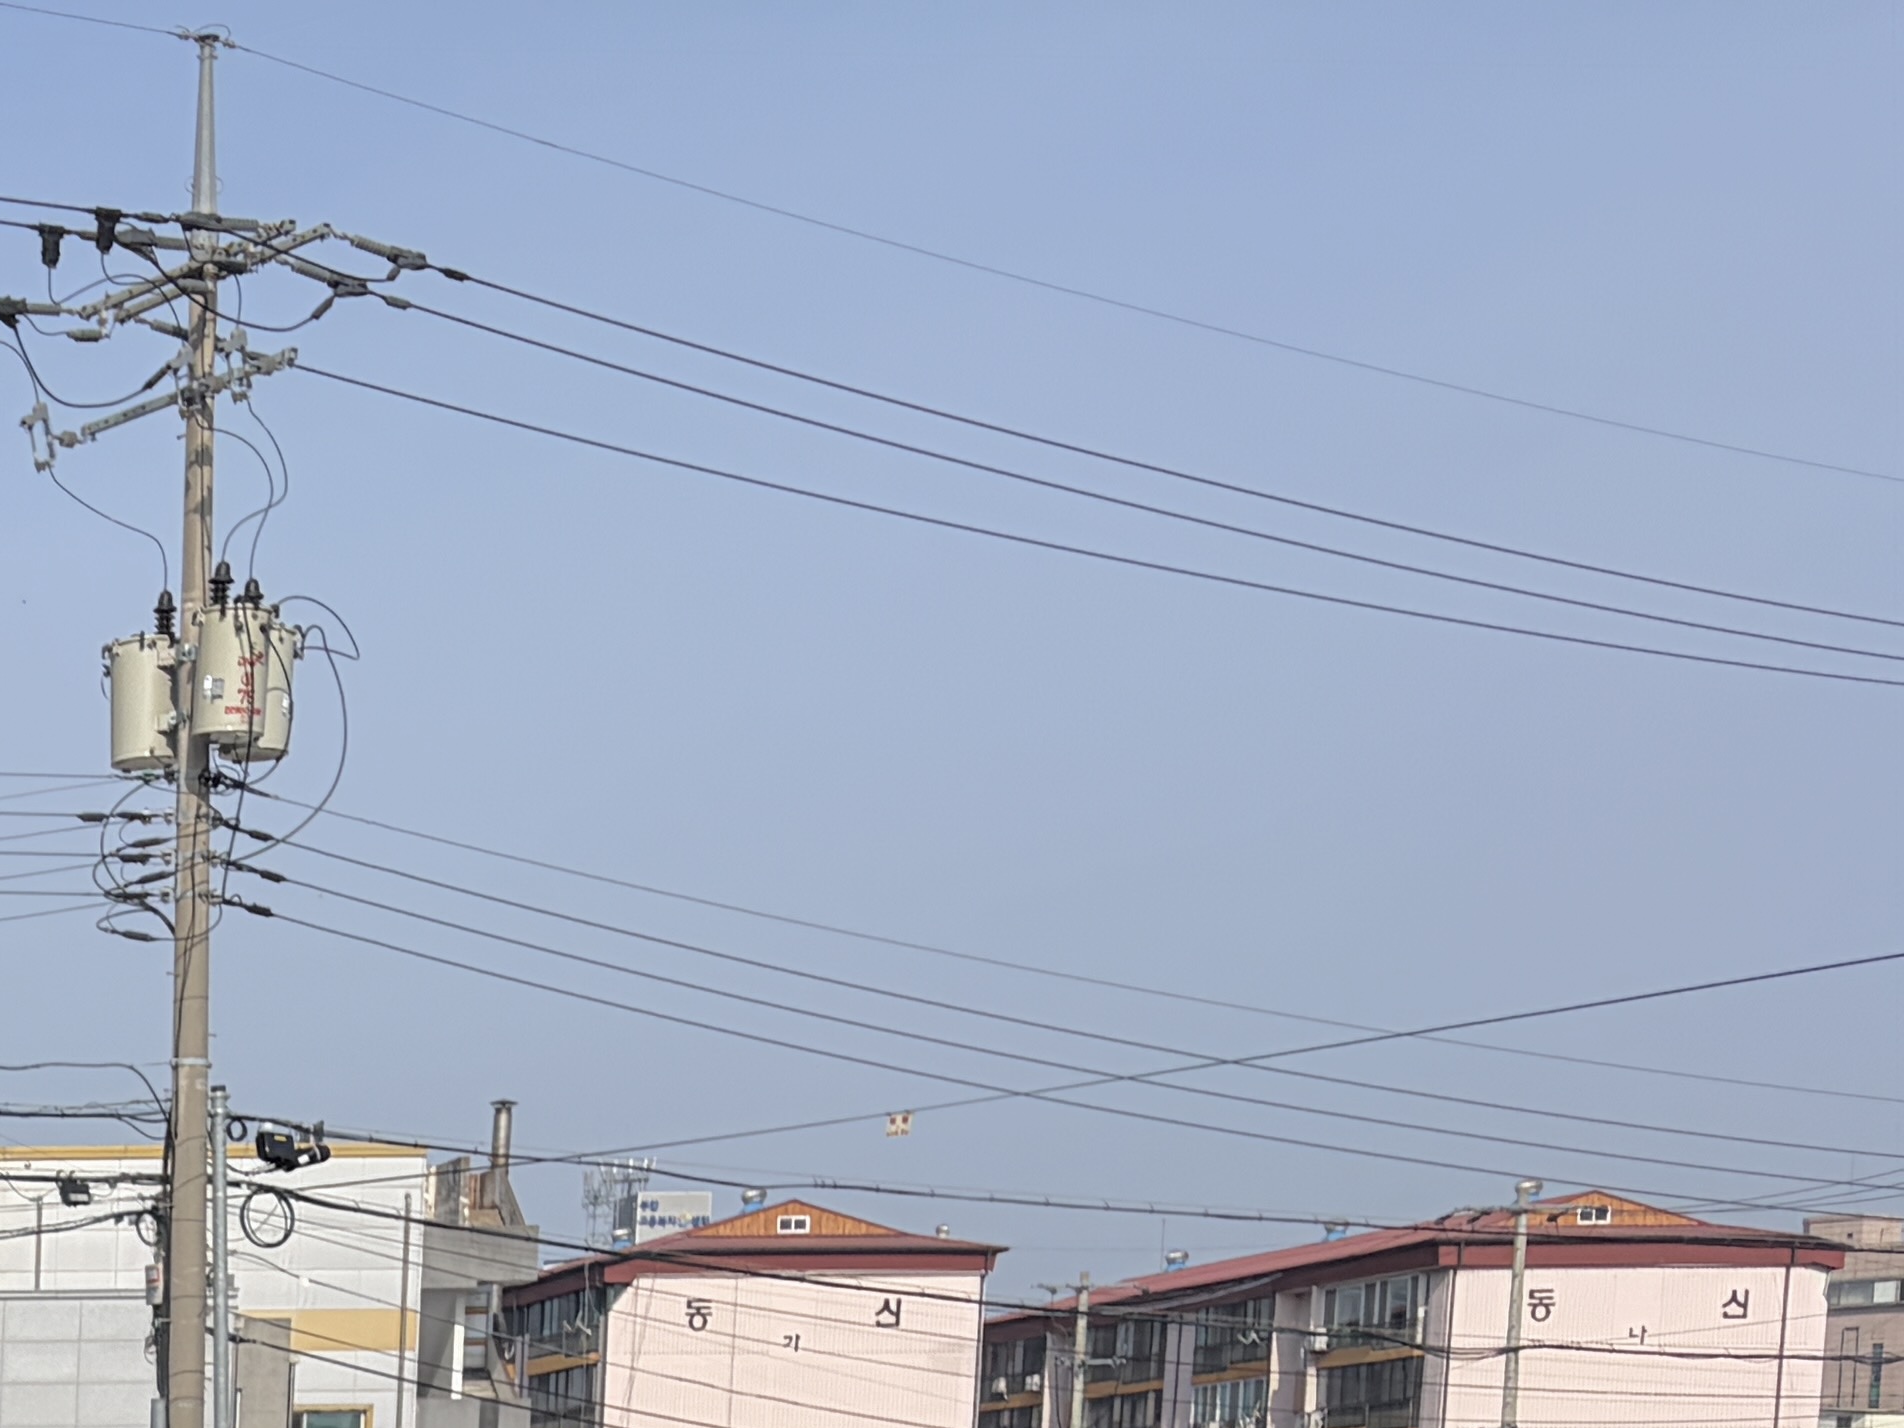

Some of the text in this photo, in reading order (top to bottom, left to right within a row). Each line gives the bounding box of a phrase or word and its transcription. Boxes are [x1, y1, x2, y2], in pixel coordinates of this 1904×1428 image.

[685, 1297, 902, 1332] 동 신
[1527, 1288, 1750, 1322] 동 신
[1628, 1325, 1648, 1346] 나
